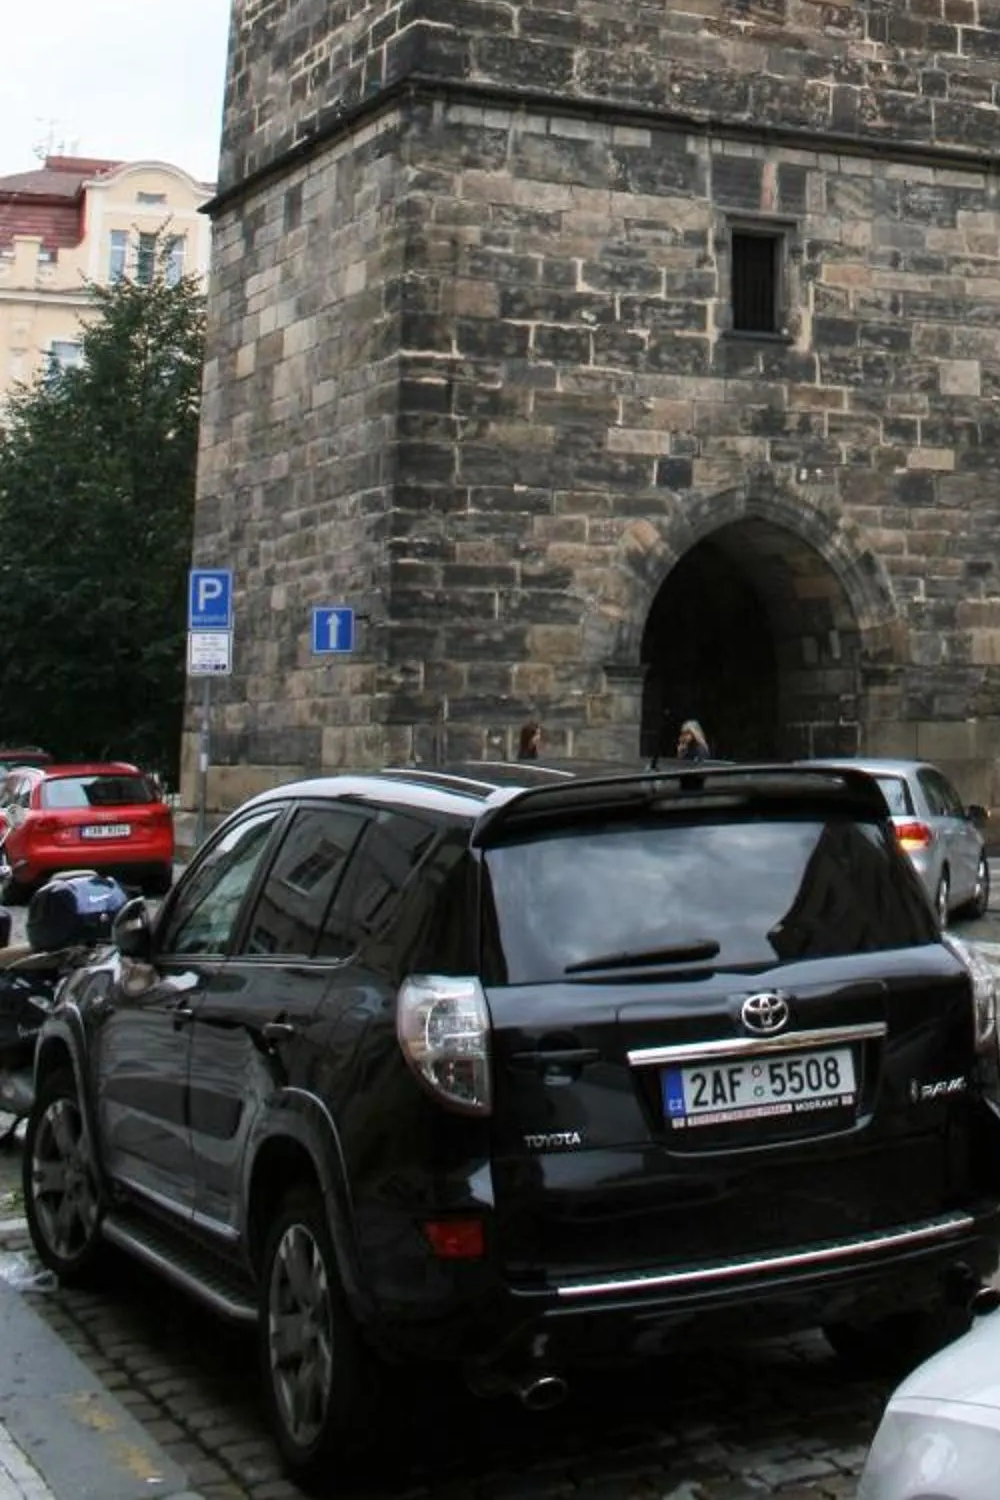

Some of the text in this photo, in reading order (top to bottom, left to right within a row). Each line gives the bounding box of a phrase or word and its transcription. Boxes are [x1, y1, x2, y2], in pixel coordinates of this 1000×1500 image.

[199, 577, 222, 612] P
[690, 1057, 841, 1107] 2AF 5508
[523, 1131, 582, 1149] TOYOTA
